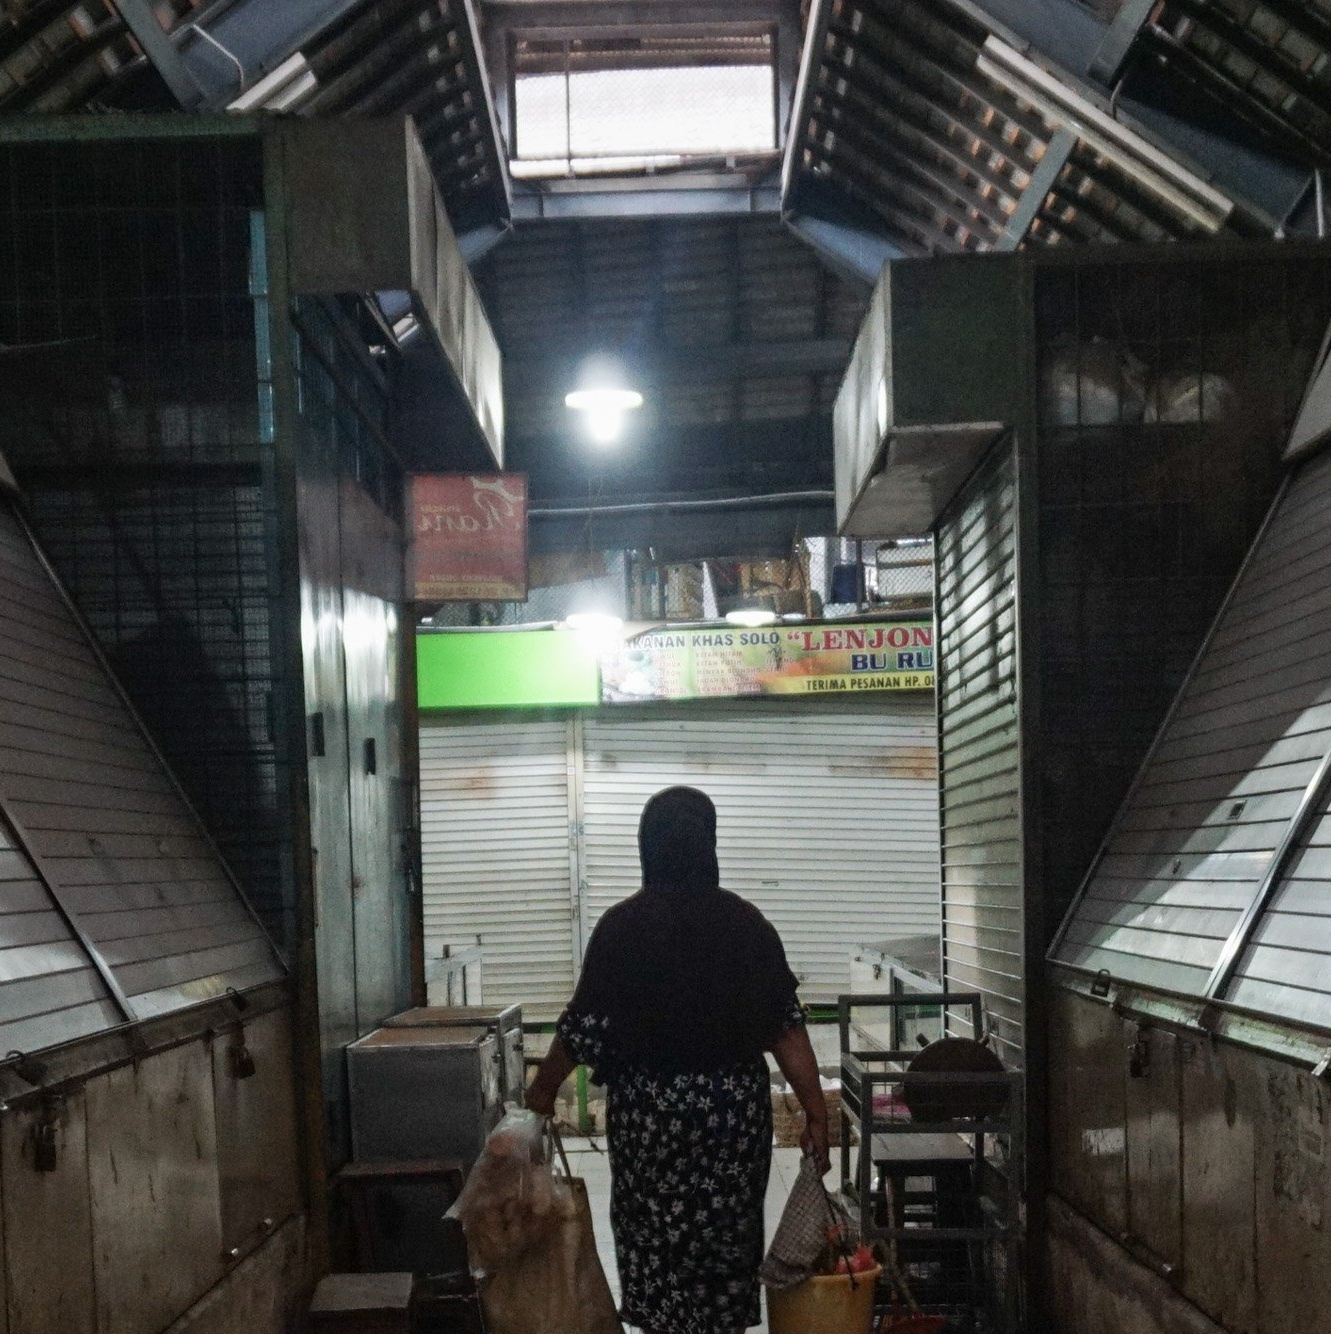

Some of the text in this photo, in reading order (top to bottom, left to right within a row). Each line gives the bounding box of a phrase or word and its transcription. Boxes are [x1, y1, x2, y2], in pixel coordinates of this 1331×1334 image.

[620, 631, 780, 649] AKANAN KHAS SOLO
[851, 653, 887, 671] BU
[806, 679, 846, 691] TERIMA
[850, 677, 901, 690] PESANAN
[905, 675, 921, 687] HP.
